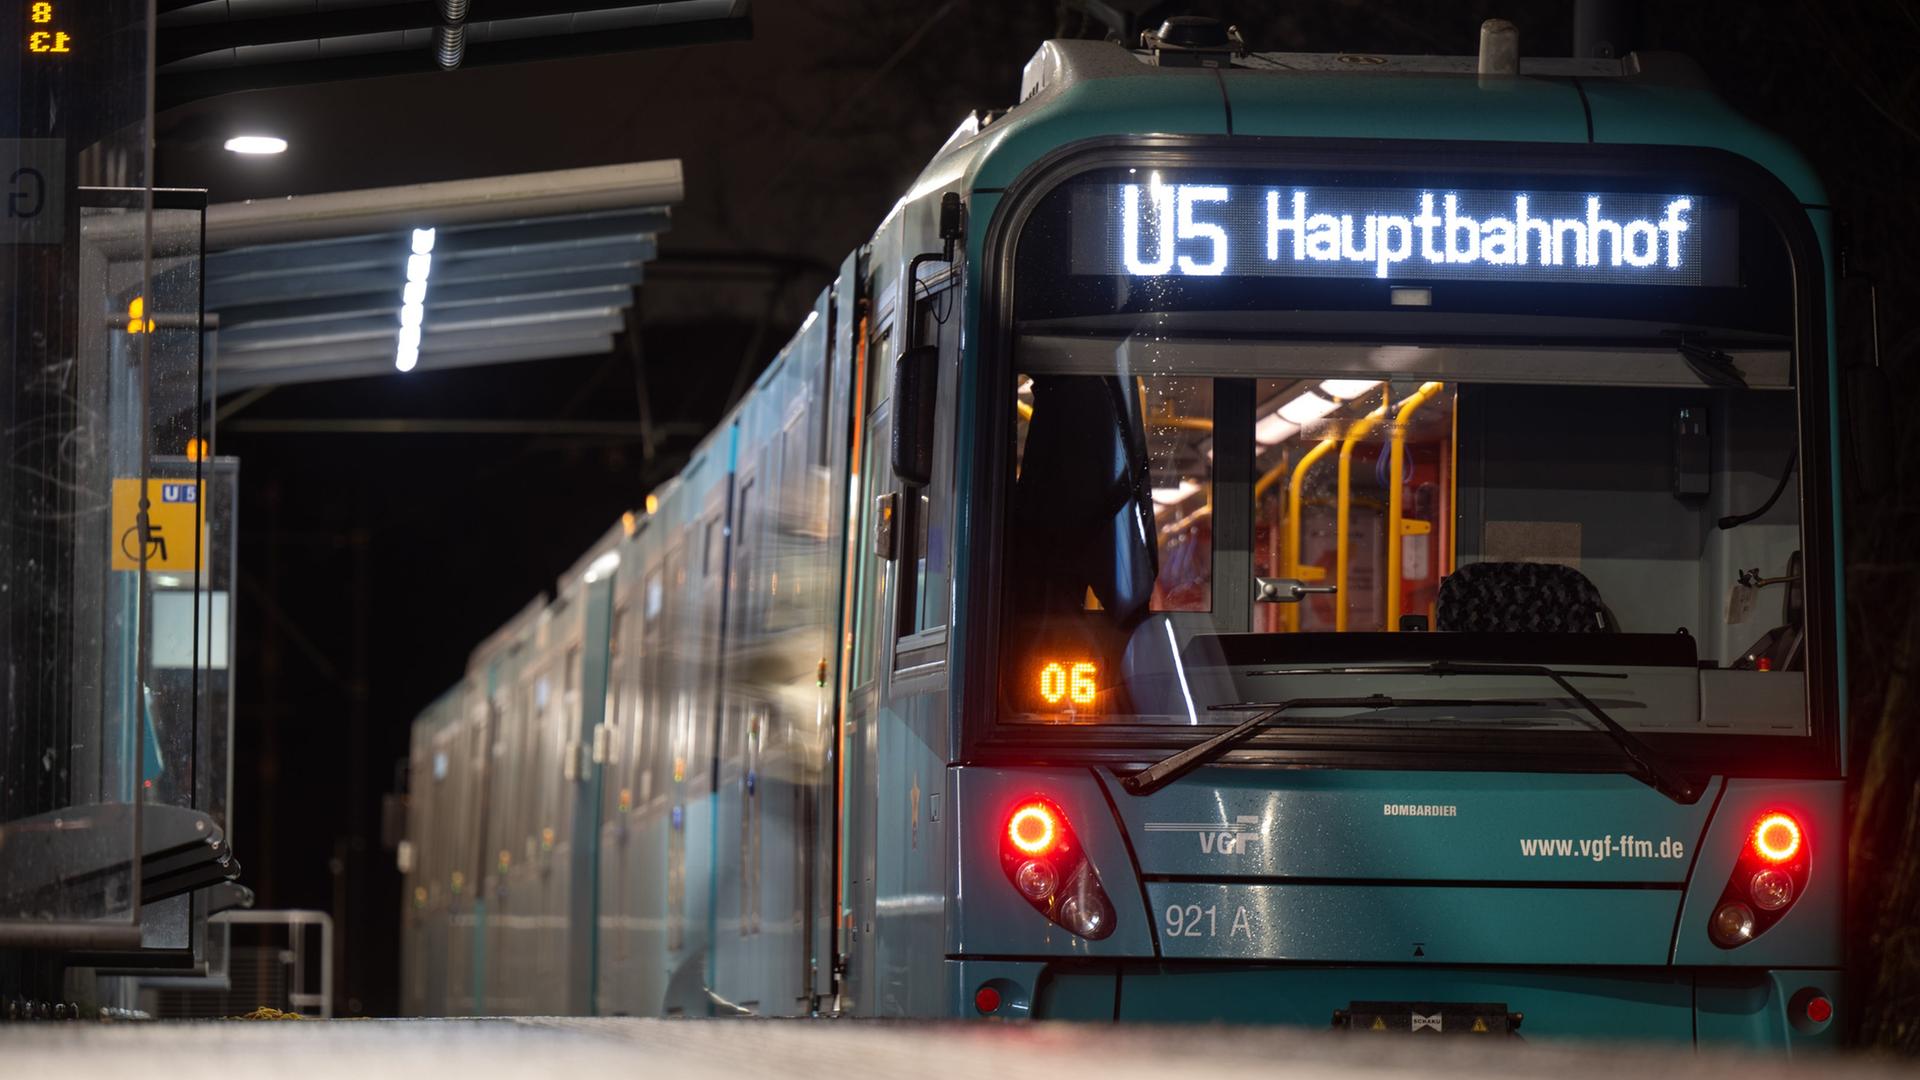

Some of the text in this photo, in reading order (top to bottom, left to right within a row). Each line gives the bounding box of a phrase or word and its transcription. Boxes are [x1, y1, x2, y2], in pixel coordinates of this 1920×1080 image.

[1121, 182, 1695, 279] U5 Hauptbahnhof
[1040, 662, 1097, 704] 06
[1383, 804, 1457, 817] BOMBARDIER
[1519, 834, 1684, 862] www.vgf-ffm.de
[1165, 904, 1252, 938] 921 A
